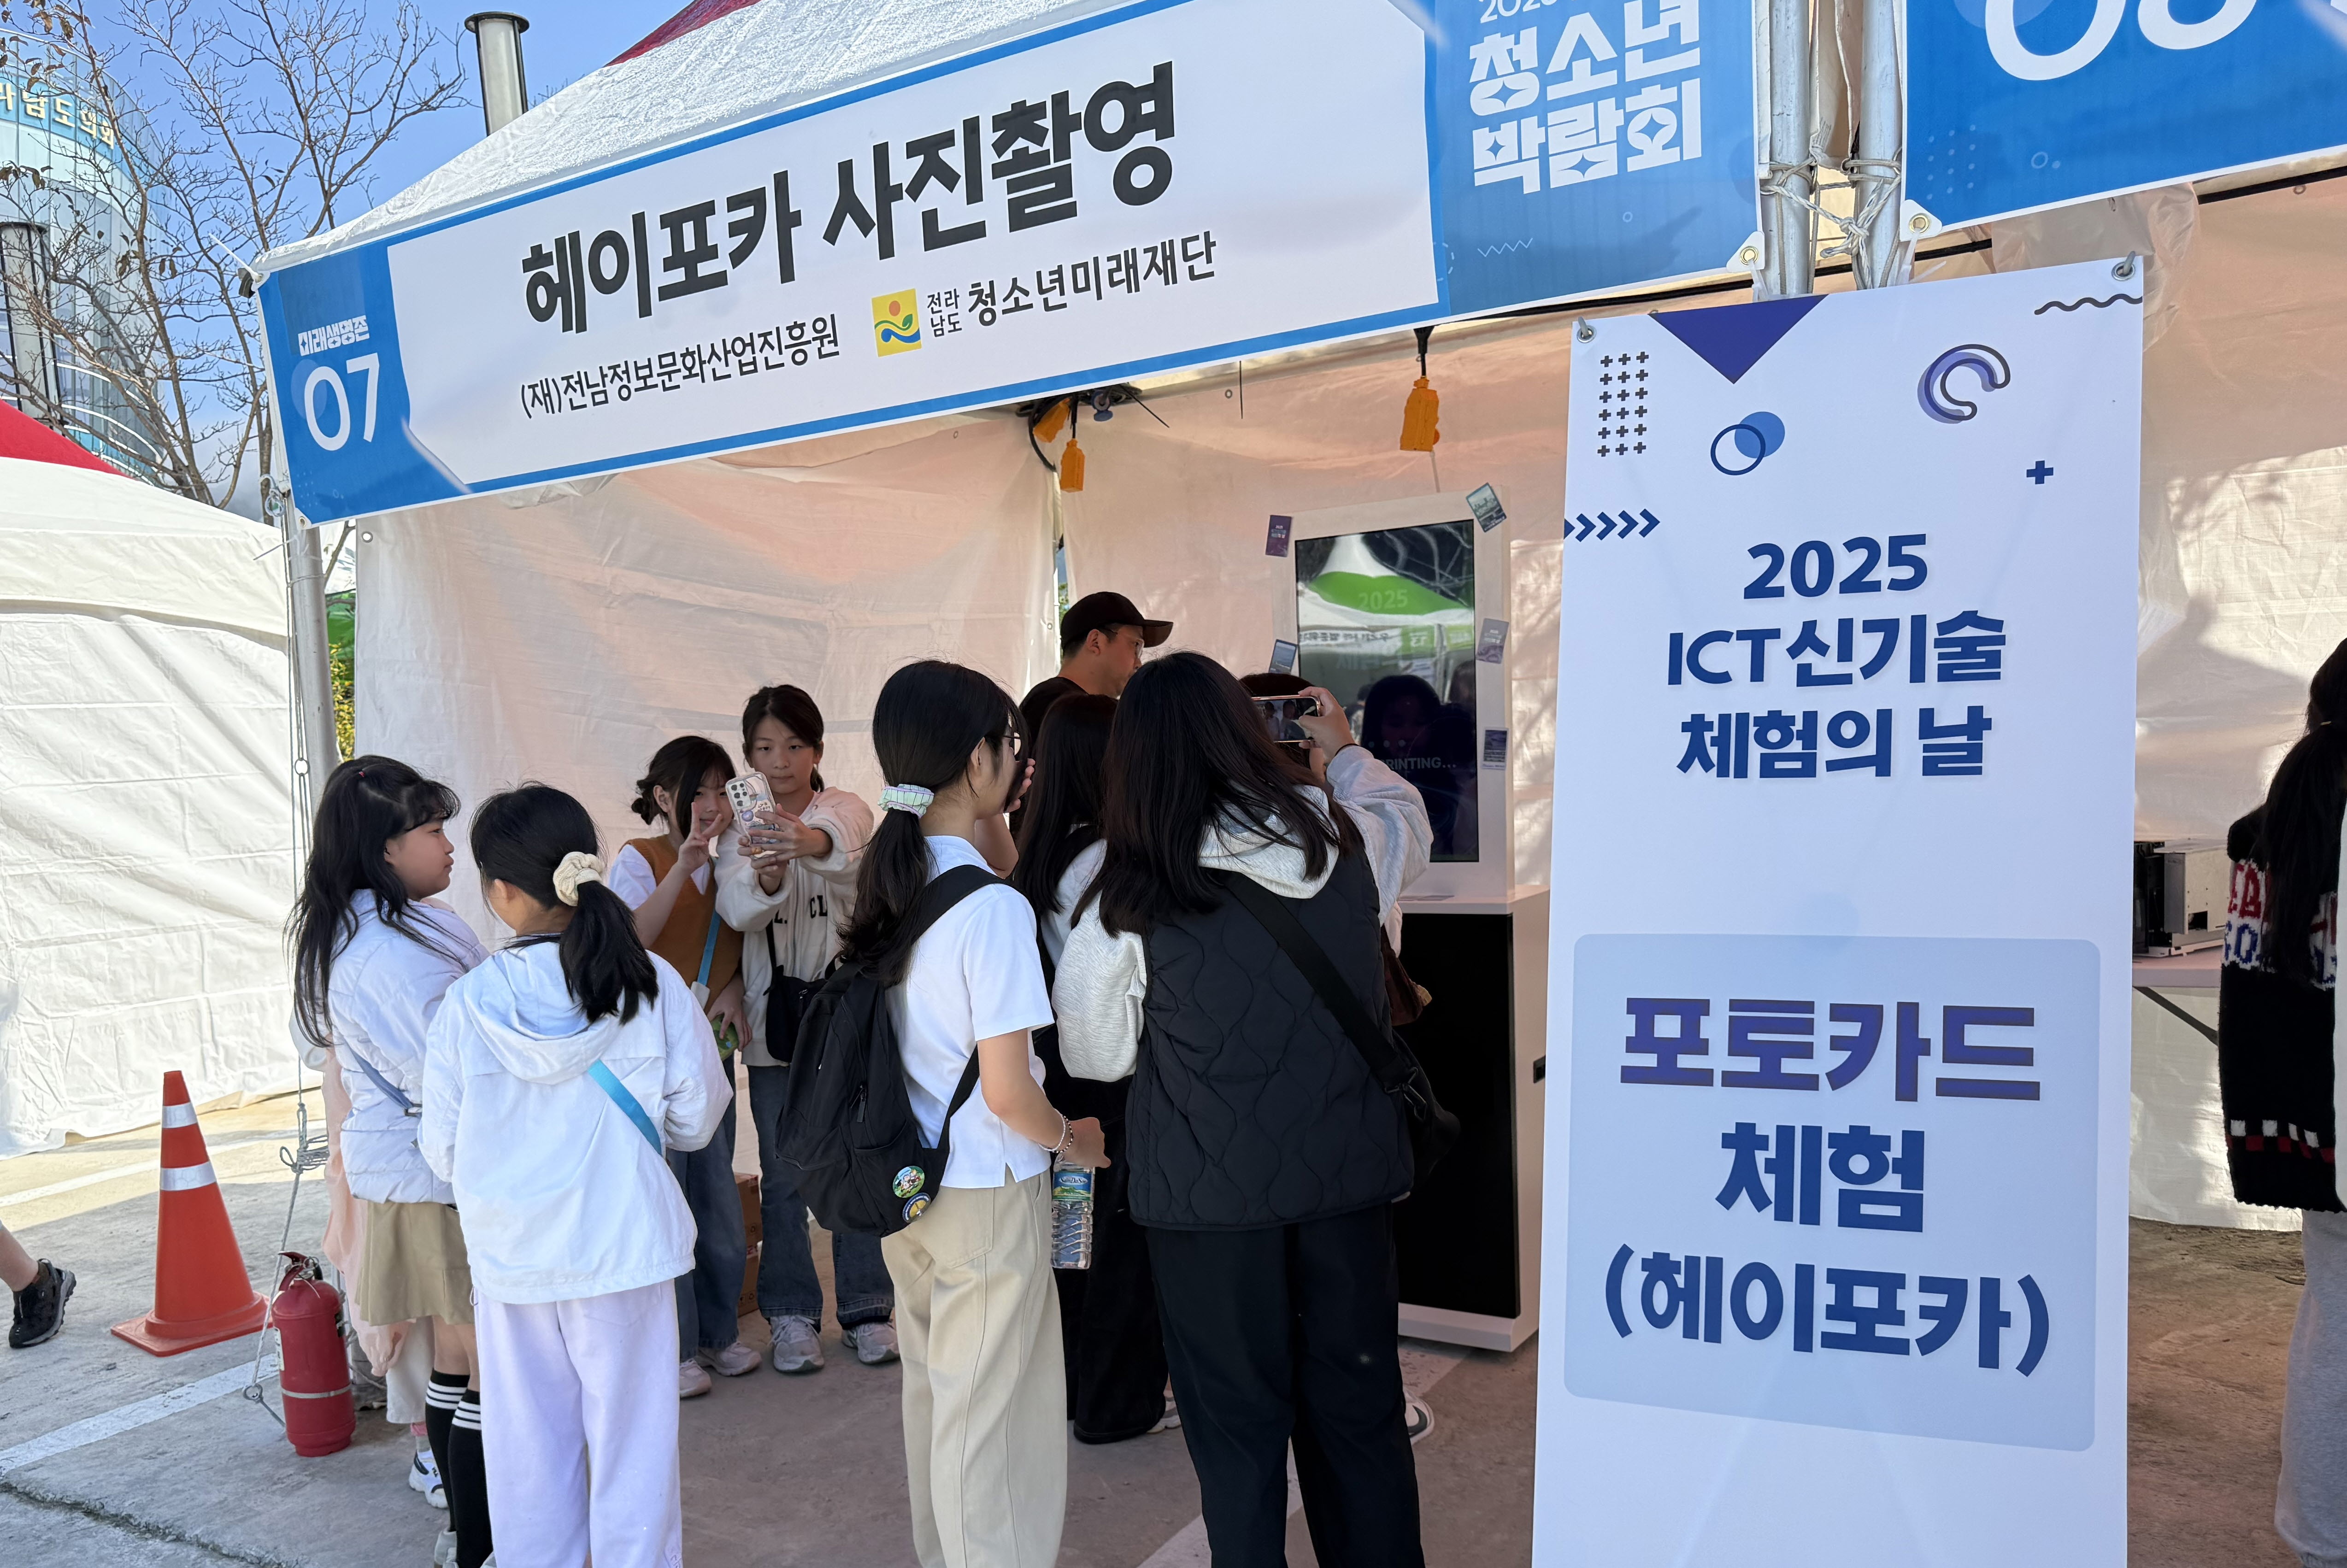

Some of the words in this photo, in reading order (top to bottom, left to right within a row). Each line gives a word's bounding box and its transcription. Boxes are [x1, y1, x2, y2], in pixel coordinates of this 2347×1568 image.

[1469, 0, 1700, 116] 청소년
[1480, 0, 1558, 23] 20
[1472, 78, 1701, 194] 박람회
[522, 170, 802, 334] 헤이포카
[822, 61, 1175, 260] 사진촬영
[927, 288, 960, 315] 전라
[930, 312, 963, 338] 남도
[968, 231, 1217, 327] 청소년미래재단
[298, 315, 370, 356] 미래생명존
[521, 314, 840, 419] (재)전남정보문화산업진흥원
[304, 352, 380, 451] 07
[1358, 588, 1408, 610] 2025
[1743, 534, 1928, 599] 2025
[1379, 757, 1457, 771] RINTING...
[1676, 708, 1892, 778] 체험의
[1918, 705, 1992, 776] 날
[1620, 998, 2040, 1102] 포토카드
[1715, 1122, 1924, 1233] 체험
[1606, 1243, 2049, 1377] (헤이포카)
